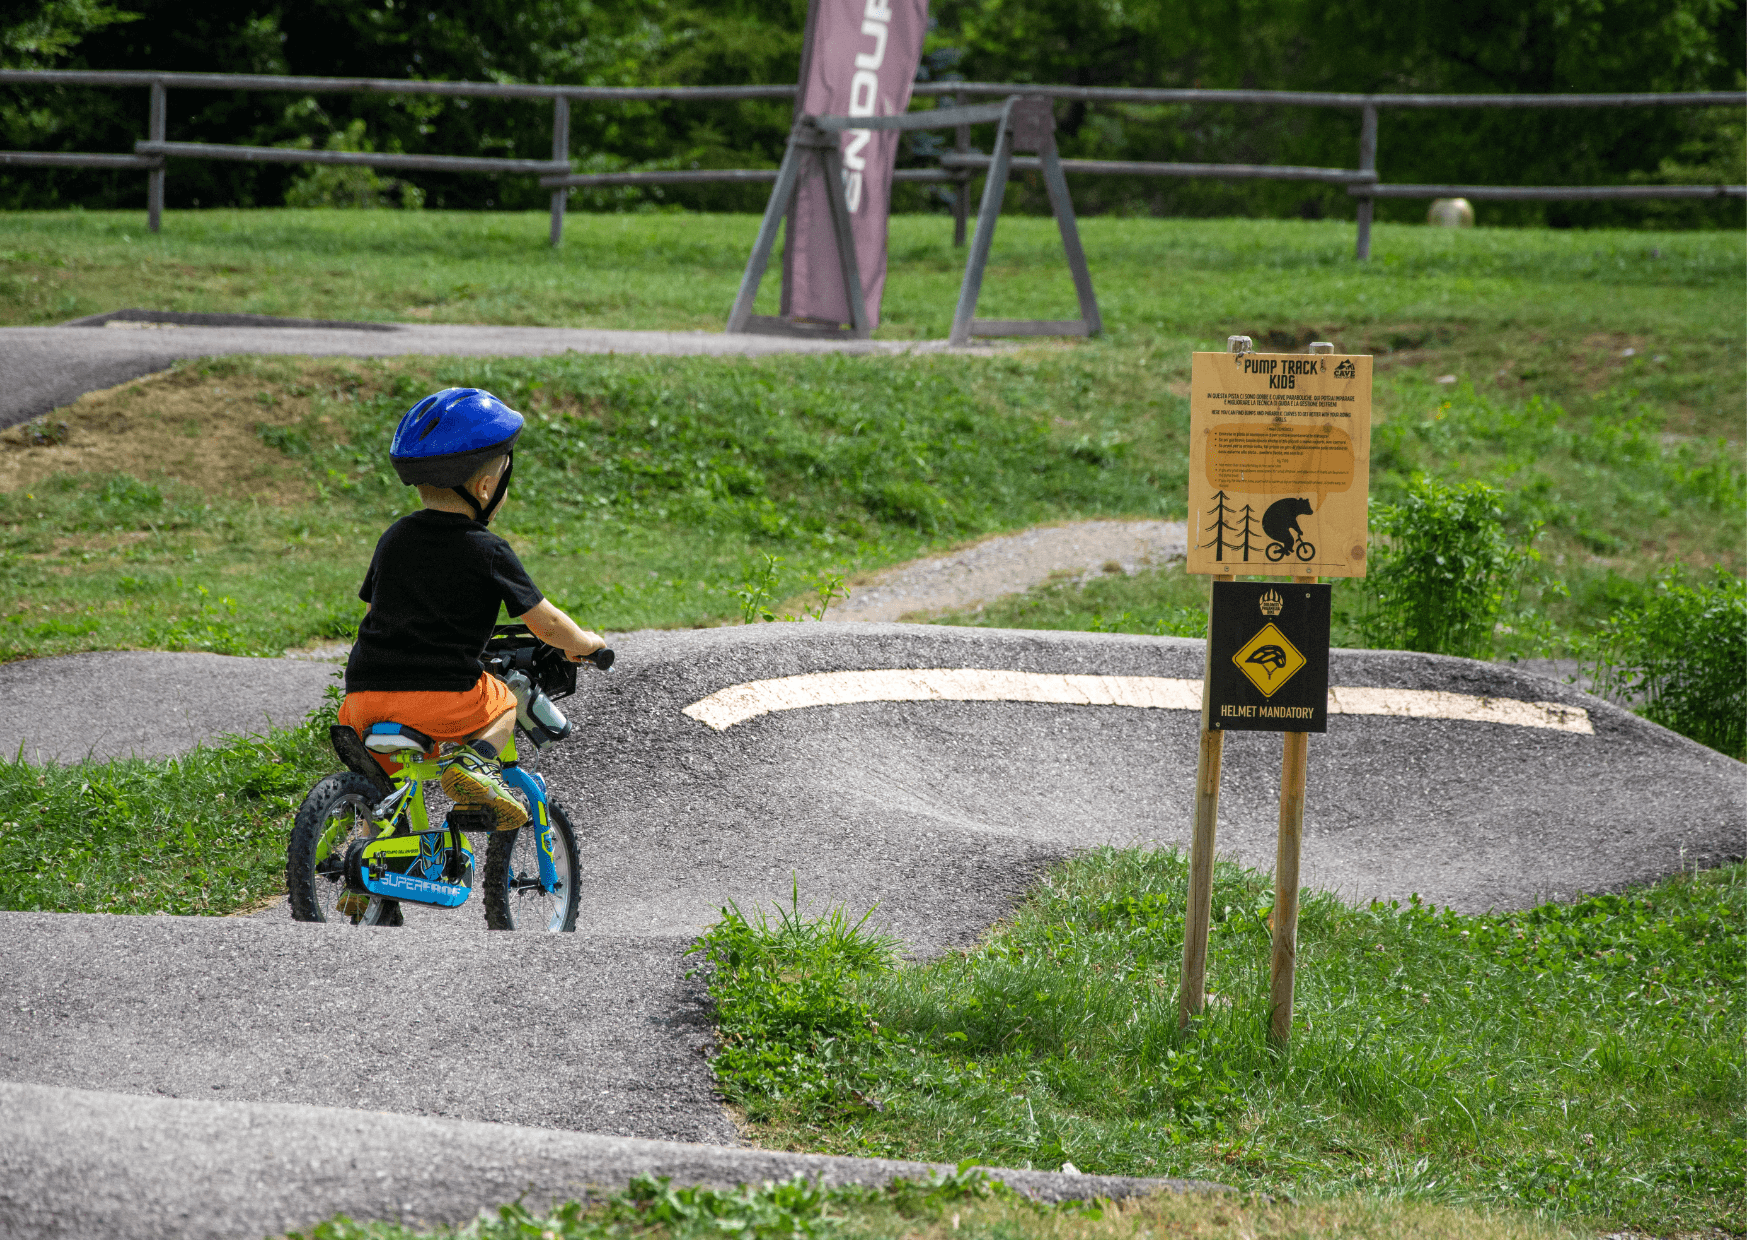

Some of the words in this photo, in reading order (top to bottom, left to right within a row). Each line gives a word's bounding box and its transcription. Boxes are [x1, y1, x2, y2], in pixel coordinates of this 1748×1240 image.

[1244, 359, 1277, 374] PUMP
[1281, 360, 1318, 375] TRACK
[1269, 375, 1295, 389] KIDS
[1221, 704, 1257, 718] HELMET
[1259, 705, 1314, 719] MANDATORY
